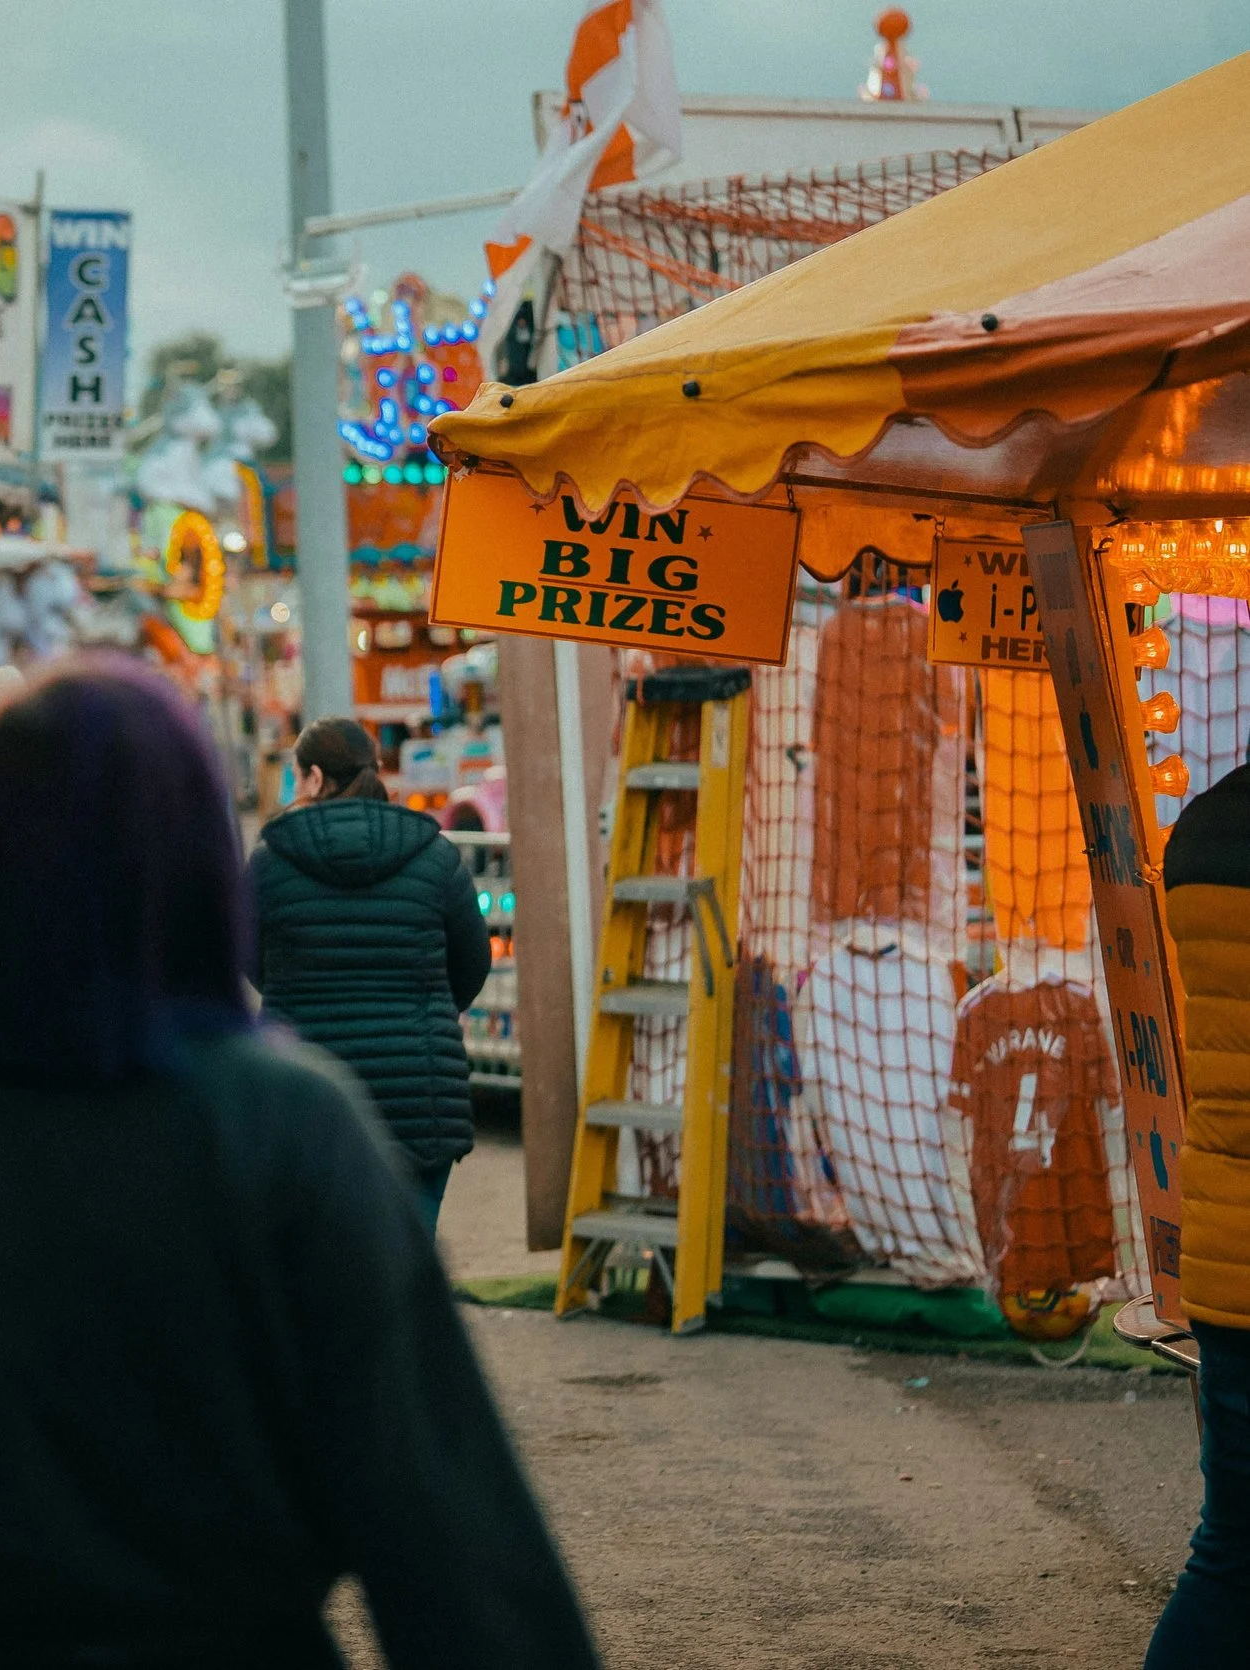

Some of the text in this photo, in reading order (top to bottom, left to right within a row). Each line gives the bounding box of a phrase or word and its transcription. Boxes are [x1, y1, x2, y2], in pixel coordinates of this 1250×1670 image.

[49, 219, 128, 250] WIN
[69, 257, 105, 404] CASH
[561, 494, 690, 545] WIN
[539, 539, 699, 592] BIG
[977, 551, 1030, 577] WI
[496, 579, 727, 641] PRIZES
[1117, 1007, 1168, 1098] I-PAD
[1006, 1072, 1058, 1169] 4
